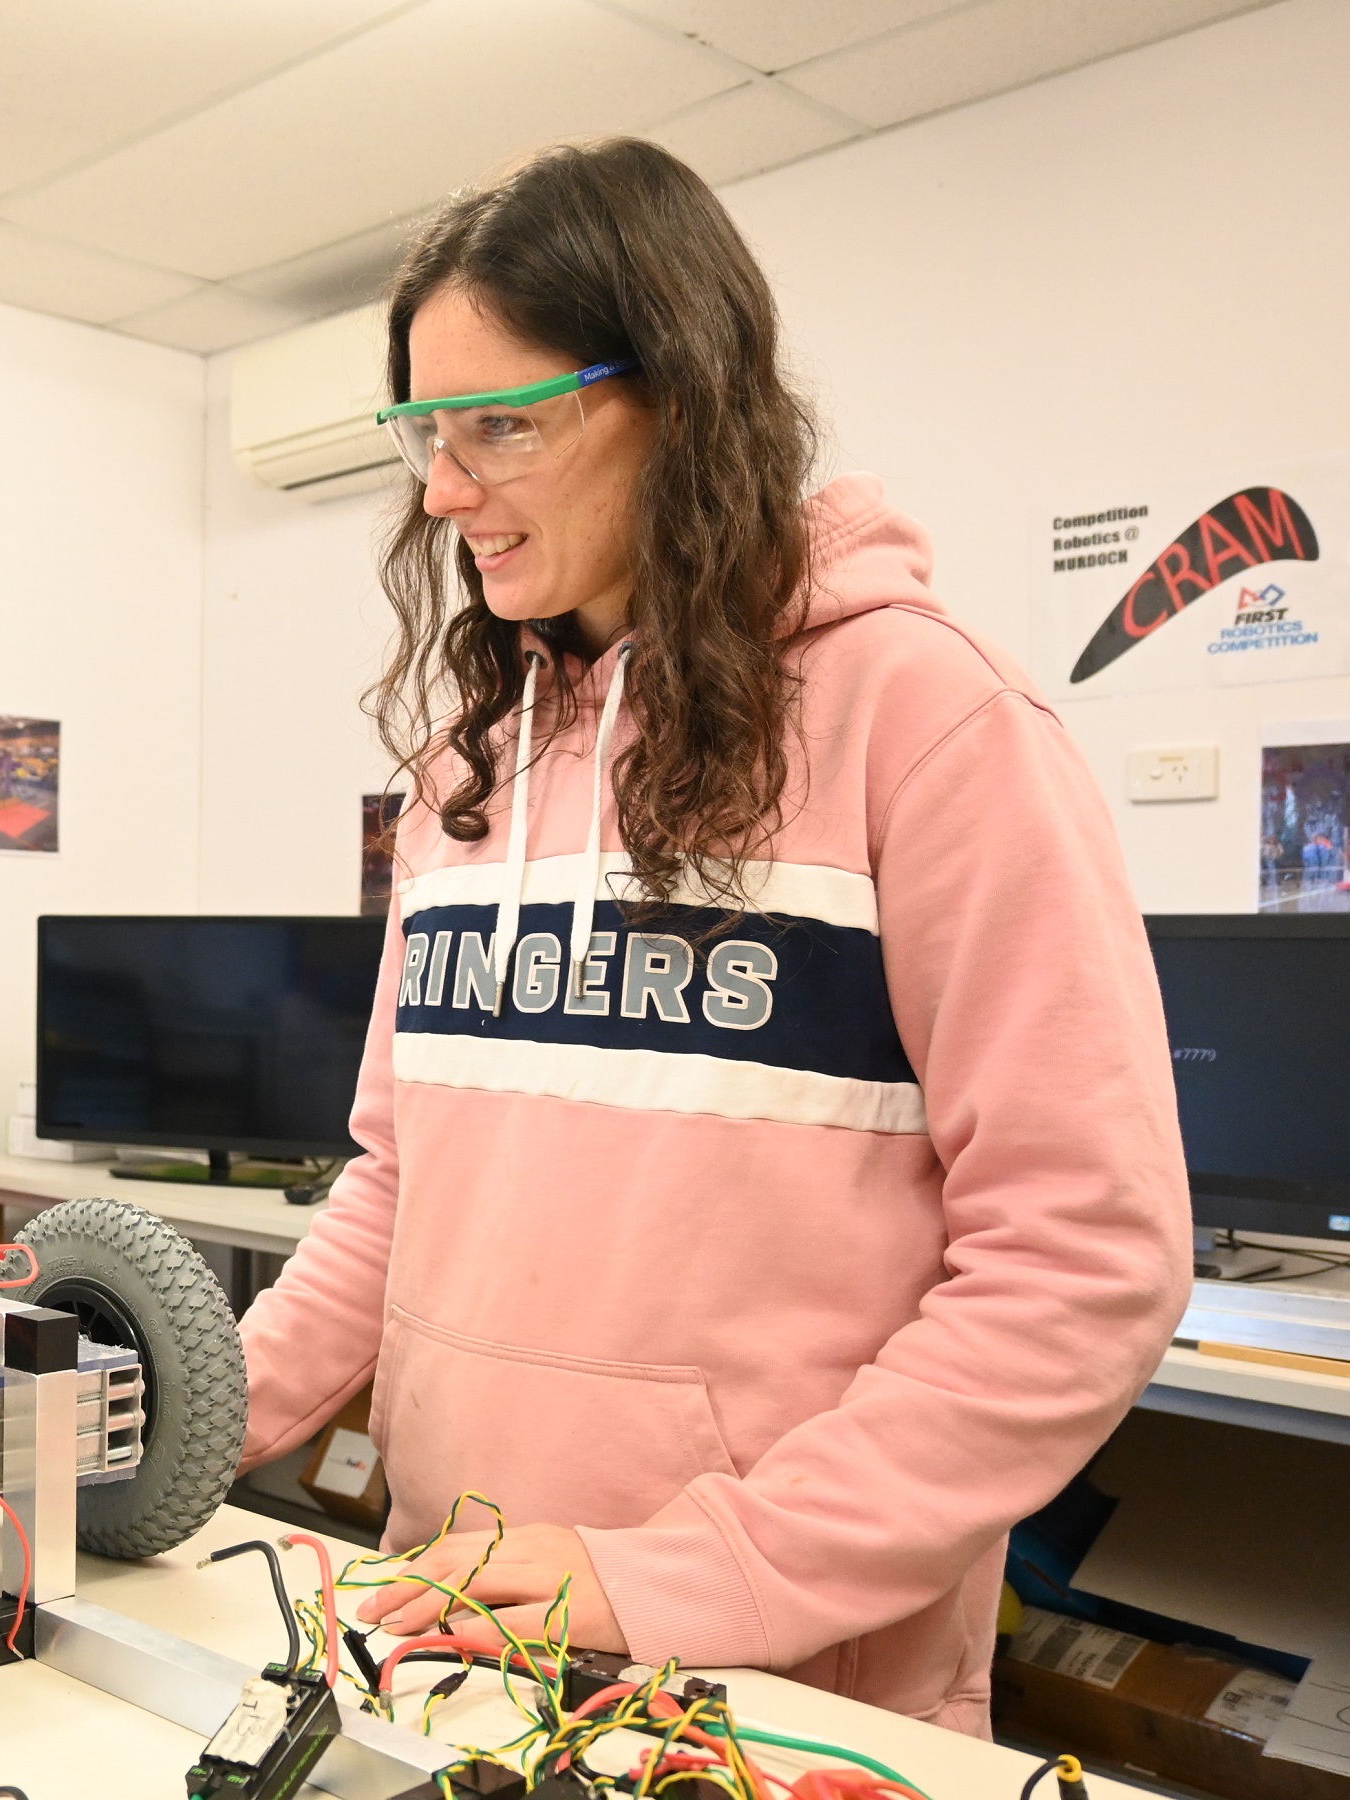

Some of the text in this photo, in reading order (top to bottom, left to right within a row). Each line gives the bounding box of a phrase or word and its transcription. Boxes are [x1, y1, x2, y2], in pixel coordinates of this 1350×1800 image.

[583, 366, 610, 382] Making
[1052, 505, 1149, 530] Competition
[1053, 525, 1140, 551] Robotics @
[1053, 549, 1128, 572] MURDOCH
[1123, 487, 1306, 638] CRAM
[1234, 607, 1289, 625] FIRST
[1220, 621, 1303, 639] ROBOTICS
[1207, 632, 1319, 654] COMPETITION
[398, 930, 779, 1031] RINGERS
